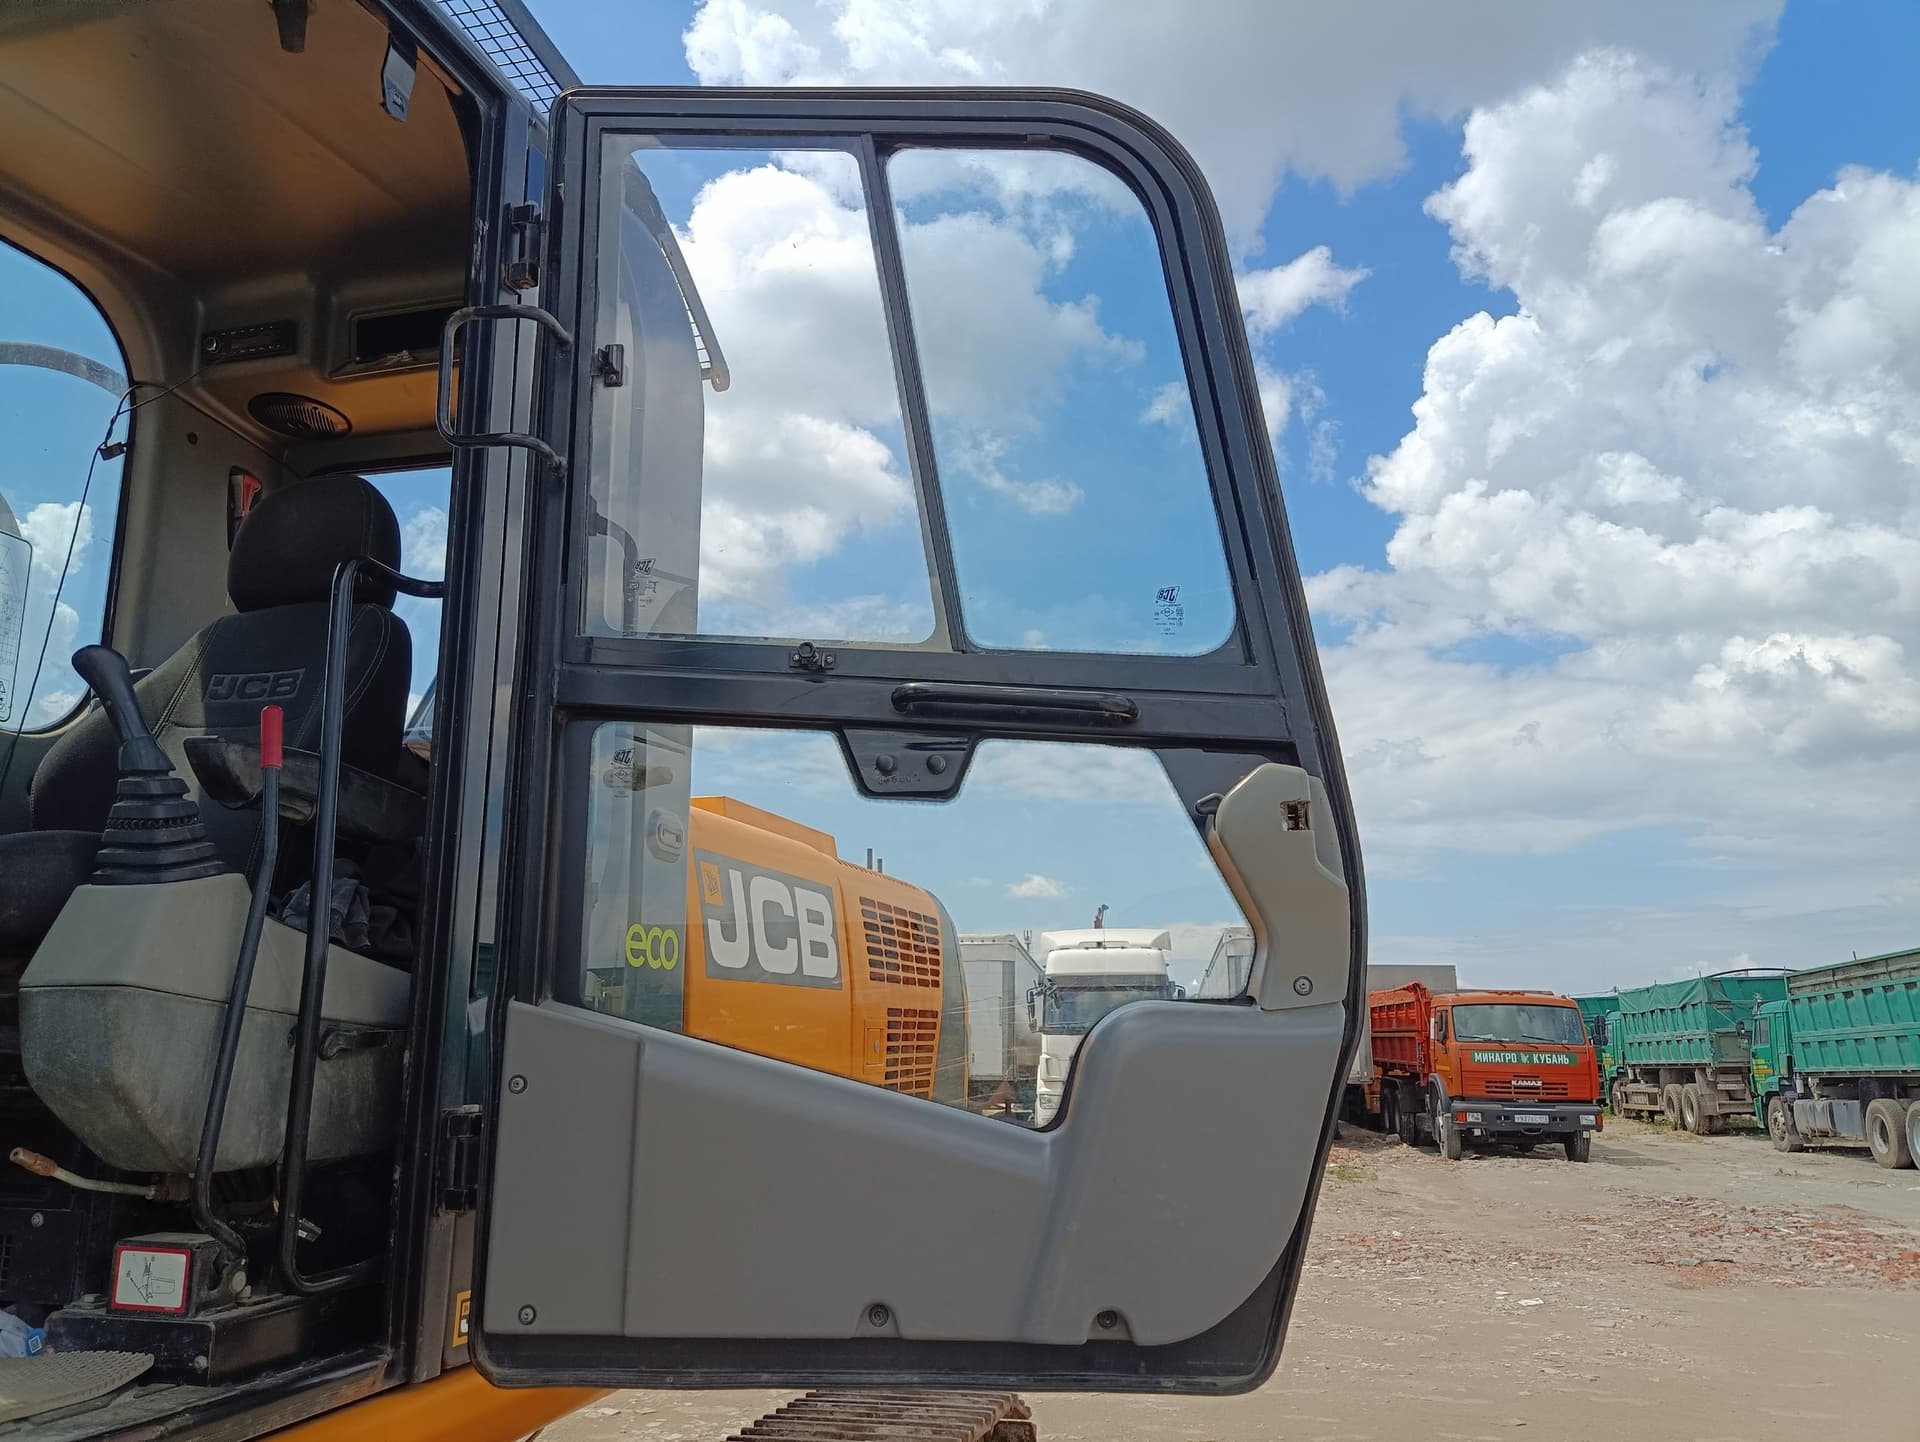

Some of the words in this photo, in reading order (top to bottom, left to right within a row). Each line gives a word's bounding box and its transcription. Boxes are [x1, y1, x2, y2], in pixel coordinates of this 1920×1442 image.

[205, 672, 304, 700] JCB
[707, 868, 839, 979] JCB
[625, 923, 679, 970] eco
[1474, 1052, 1517, 1063] МИНАГРО
[1533, 1053, 1569, 1065] КУБАНЬ
